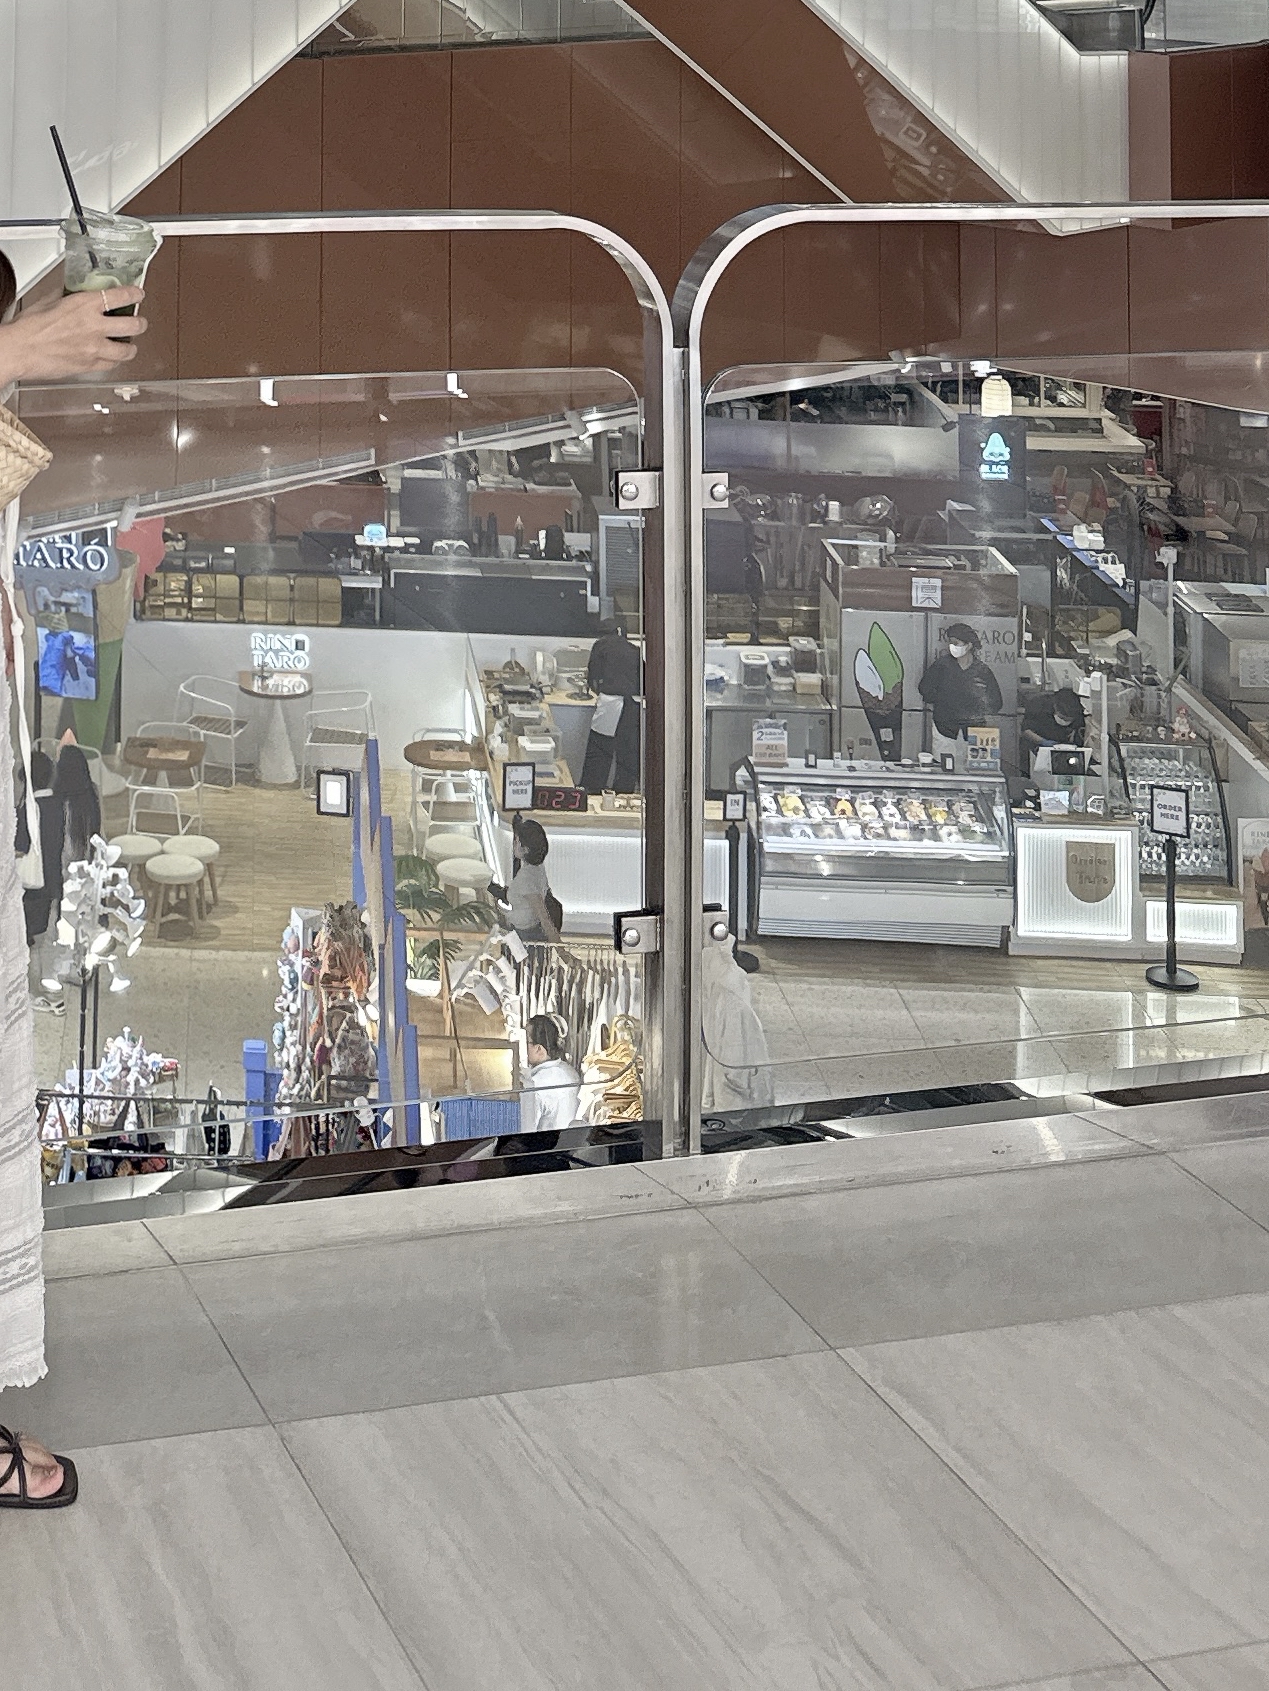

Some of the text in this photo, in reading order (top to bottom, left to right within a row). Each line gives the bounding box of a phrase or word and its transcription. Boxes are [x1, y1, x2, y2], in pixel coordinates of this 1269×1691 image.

[252, 651, 310, 670] TARO
[1156, 802, 1183, 813] ORDER
[1160, 812, 1181, 821] HERE
